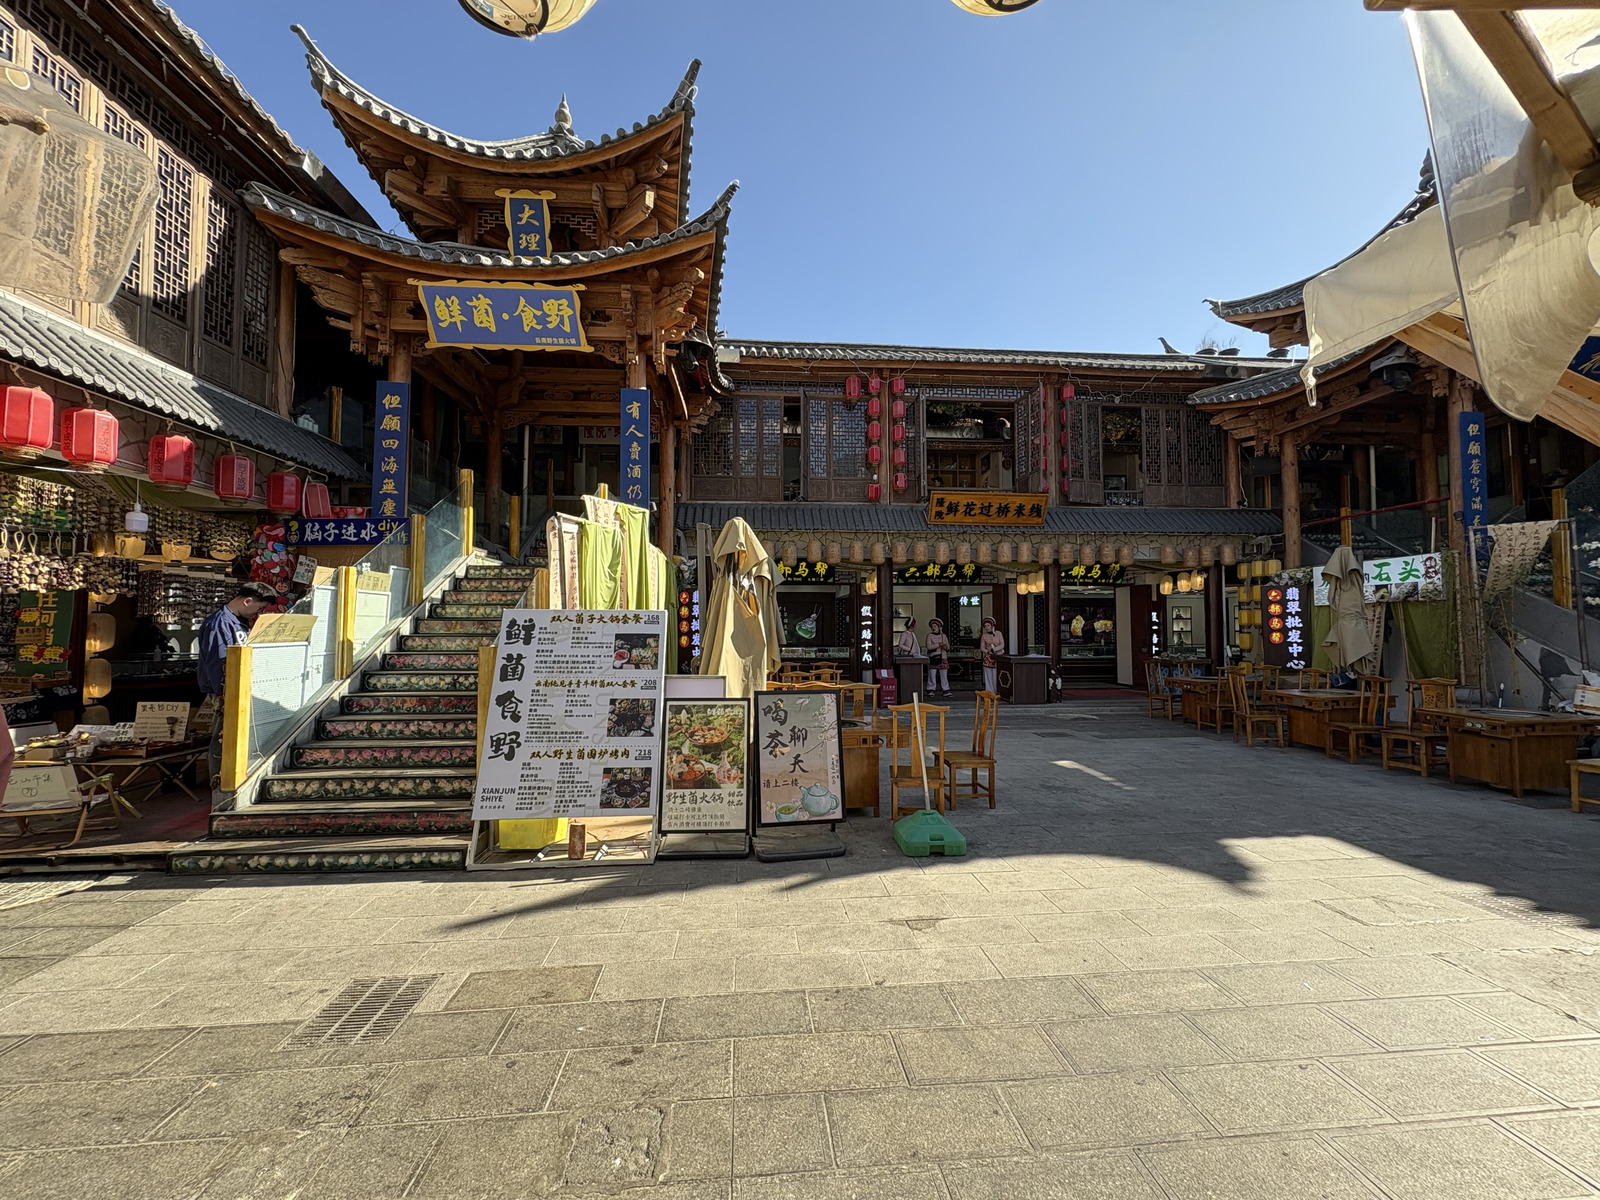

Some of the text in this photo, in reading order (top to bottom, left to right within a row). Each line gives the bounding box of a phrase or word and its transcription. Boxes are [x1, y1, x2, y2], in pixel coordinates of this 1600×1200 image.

[516, 203, 540, 251] 大理
[434, 293, 574, 333] 鲜菌·食野
[625, 401, 645, 505] 有人賣酒仍
[945, 500, 1043, 519] 鲜花过桥米线
[303, 521, 378, 543] 脑子进水
[378, 519, 399, 531] diy
[905, 562, 976, 579] 六部马帮
[1060, 563, 1120, 579] 部马帮
[959, 595, 980, 606] 传世
[1267, 590, 1281, 643] 六部马帮
[1285, 586, 1306, 670] 翡翠批发中心
[487, 617, 537, 762] 鲜菌食野
[761, 697, 789, 759] 喝茶
[788, 724, 810, 774] 聊天
[481, 787, 517, 795] XIANJUN
[762, 777, 800, 789] 请上二楼
[480, 795, 504, 803] SHIYE
[665, 789, 724, 805] 野生菌火锅
